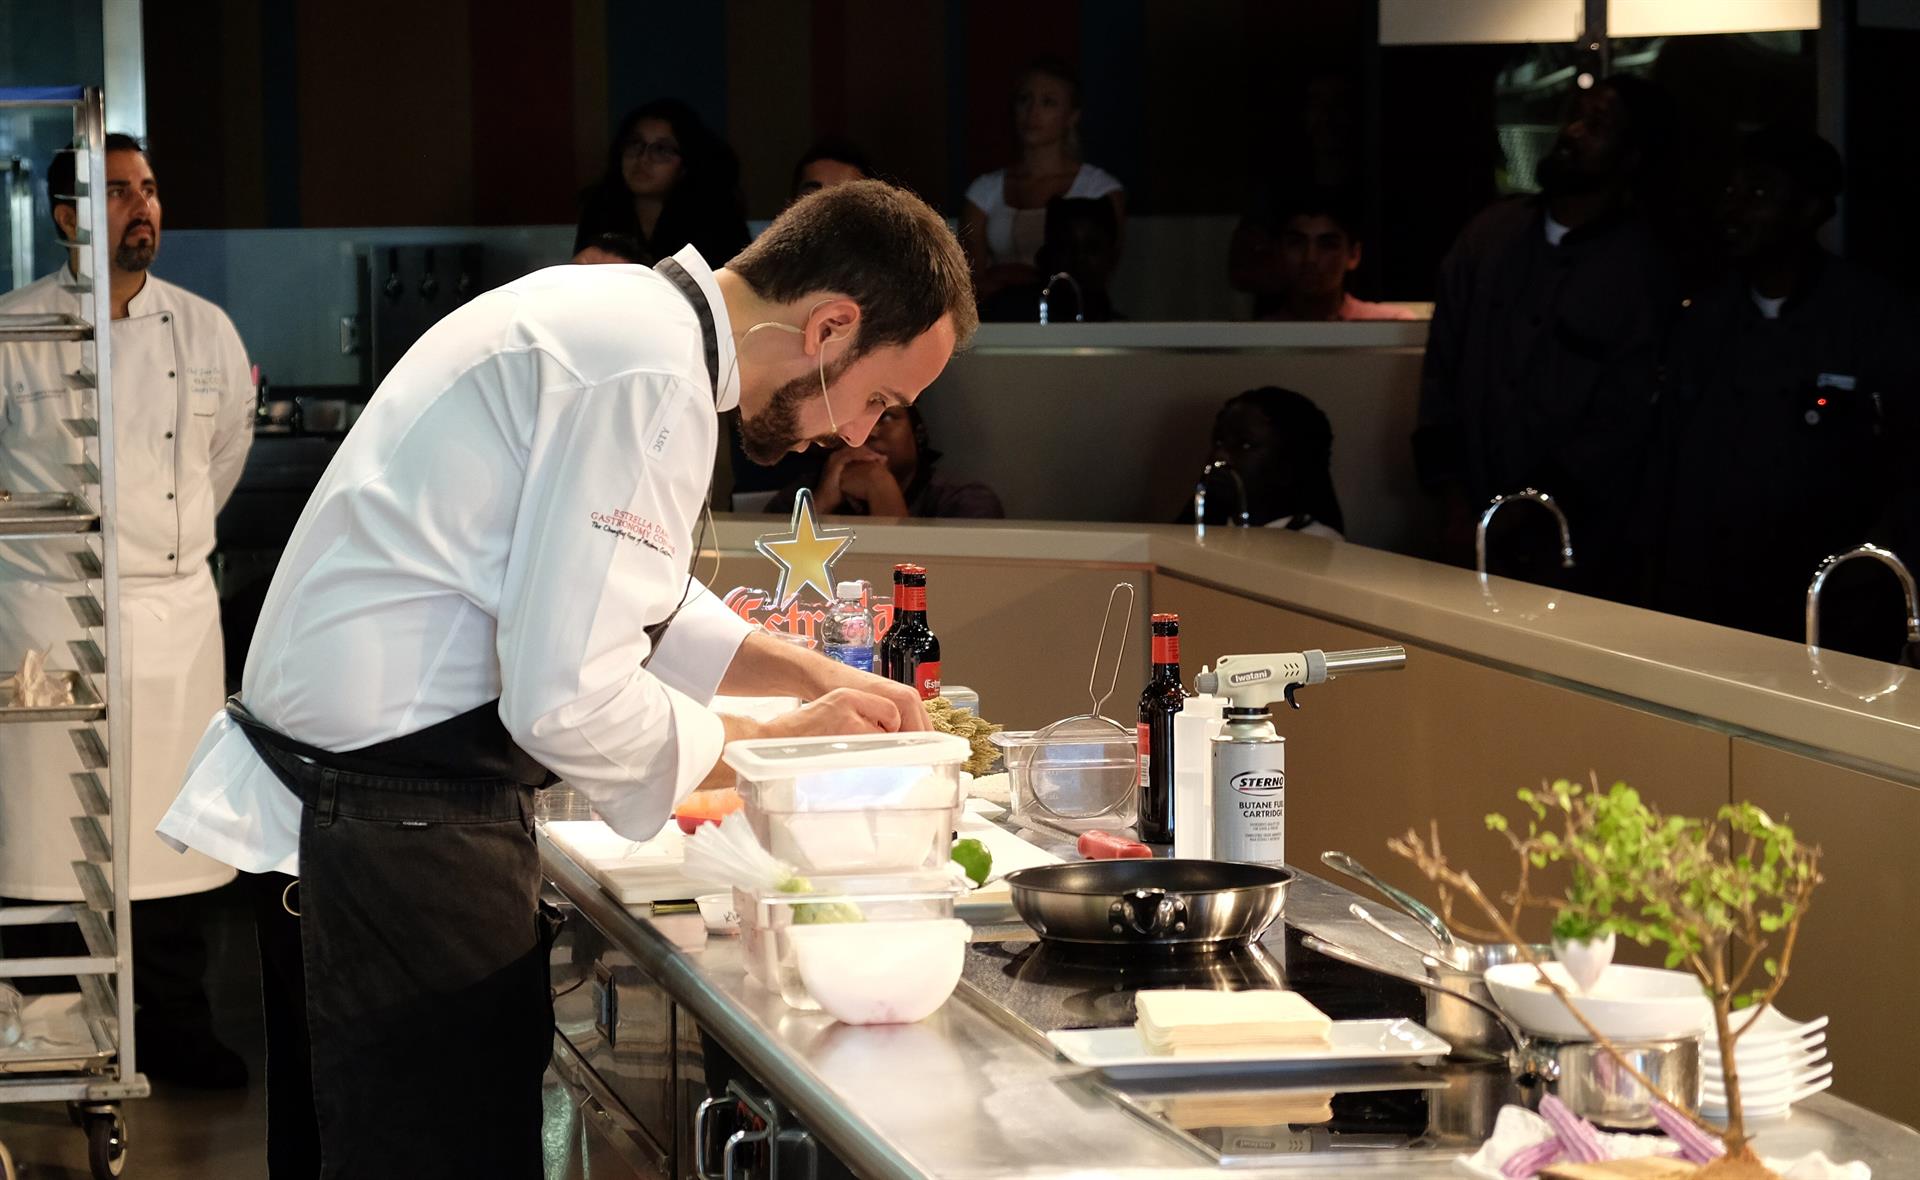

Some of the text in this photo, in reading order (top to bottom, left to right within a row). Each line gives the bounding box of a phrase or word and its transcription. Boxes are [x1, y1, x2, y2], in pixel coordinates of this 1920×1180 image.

[591, 511, 651, 538] GASTRONOMY
[614, 509, 652, 530] ESTRELLA
[729, 589, 893, 649] Estra
[1235, 670, 1268, 682] Iwatani
[1239, 777, 1283, 787] STERNO
[1238, 801, 1272, 810] BUTANE
